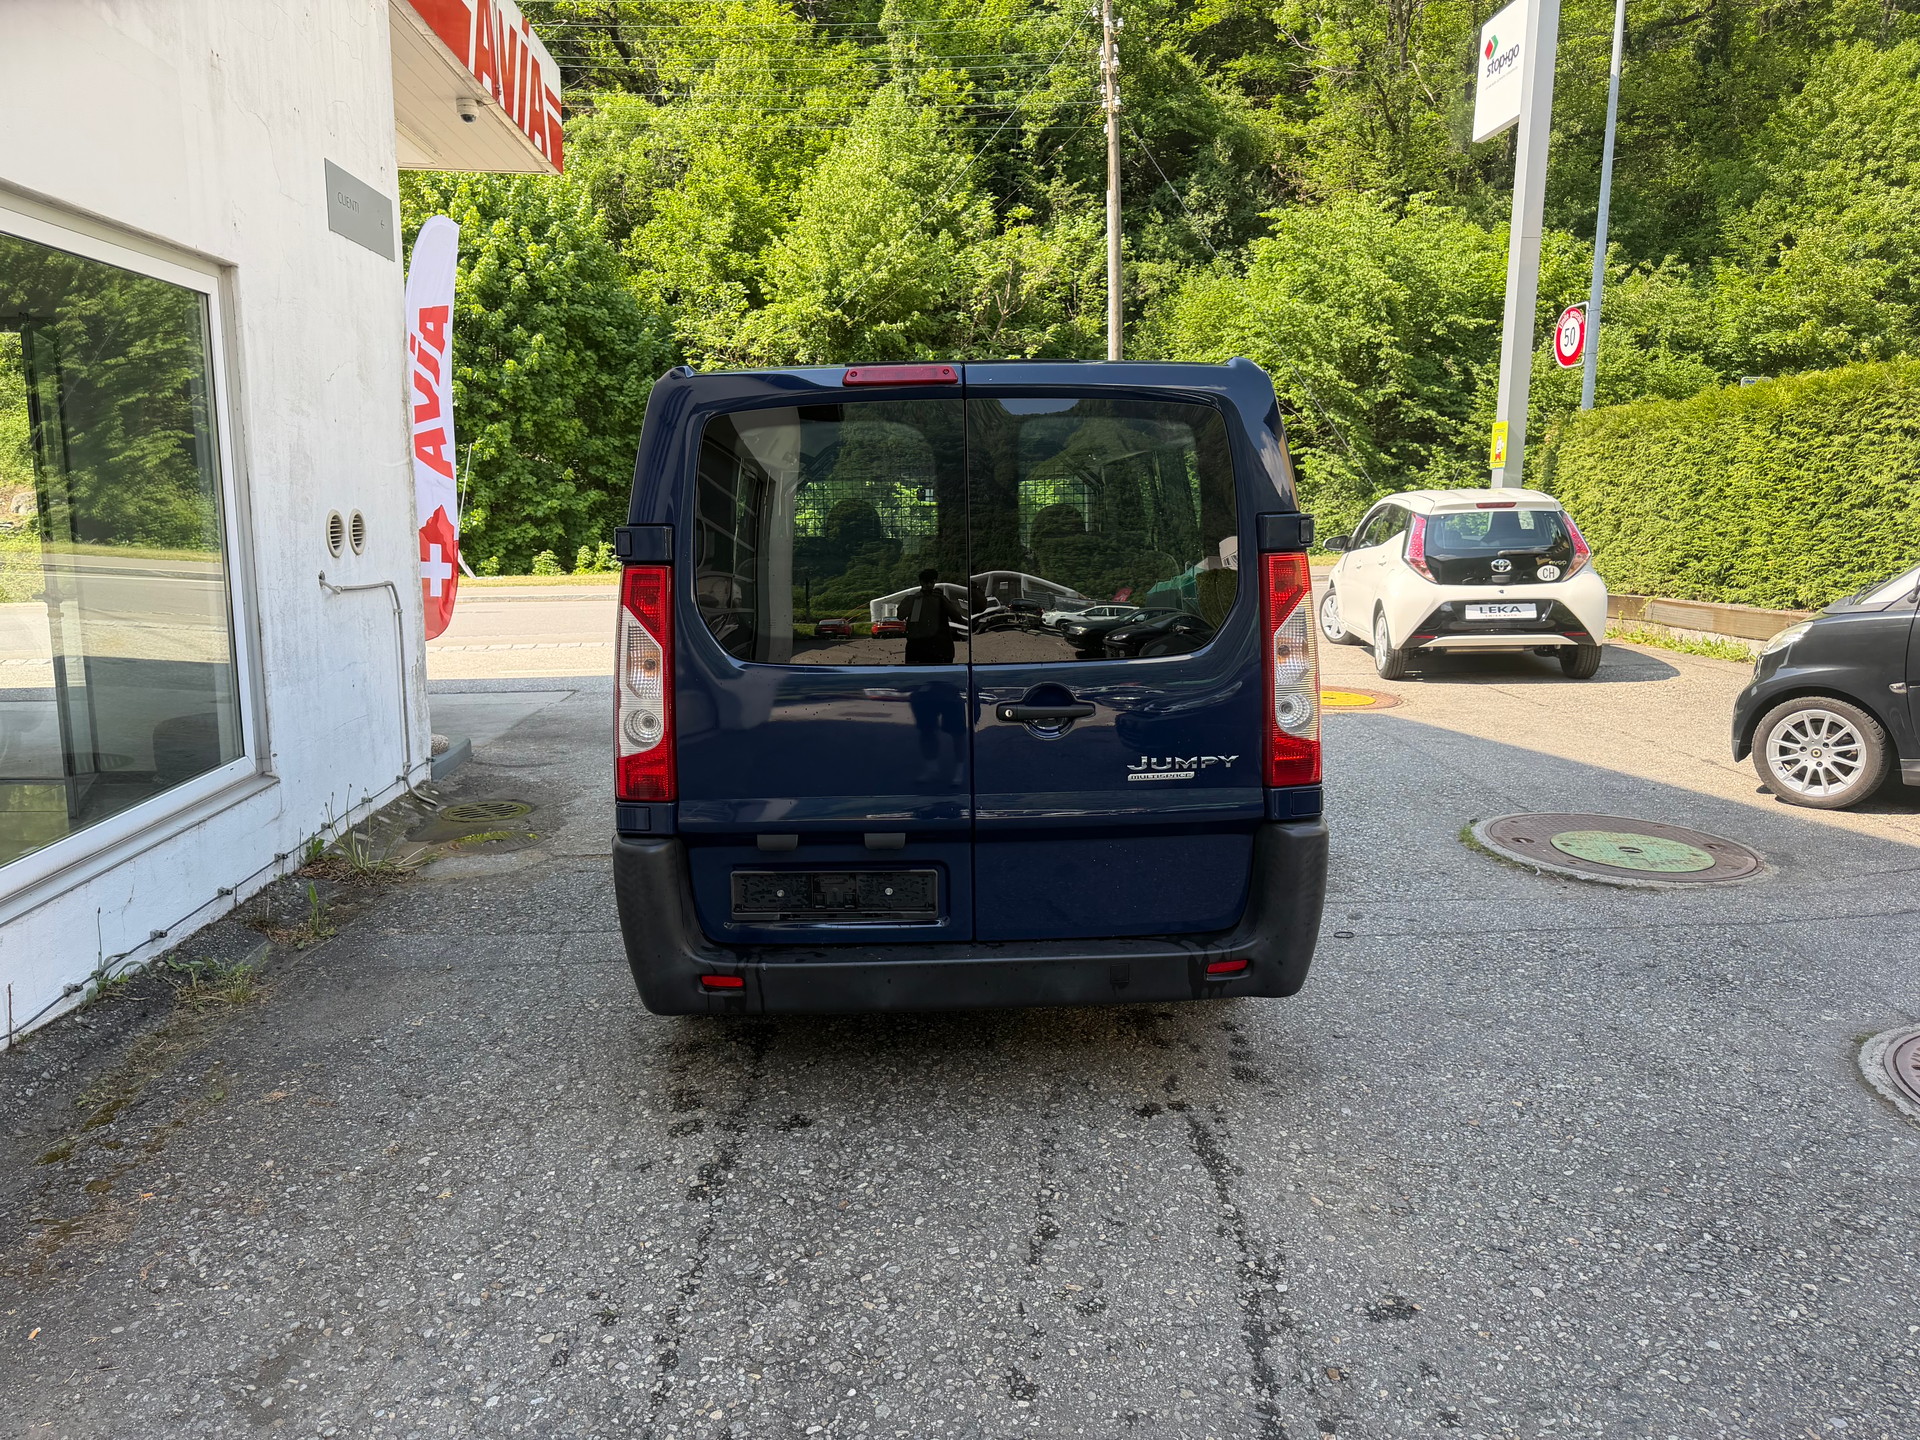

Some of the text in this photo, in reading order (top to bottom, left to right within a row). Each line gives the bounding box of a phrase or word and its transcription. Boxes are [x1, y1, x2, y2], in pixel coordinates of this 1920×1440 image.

[337, 191, 360, 215] CLIENTI
[1563, 326, 1576, 348] 50
[410, 304, 454, 480] AVIA
[1542, 567, 1555, 579] CH
[1479, 605, 1522, 614] LEKA
[1126, 755, 1240, 771] JUMPY
[1130, 772, 1192, 780] MULTISPACE
